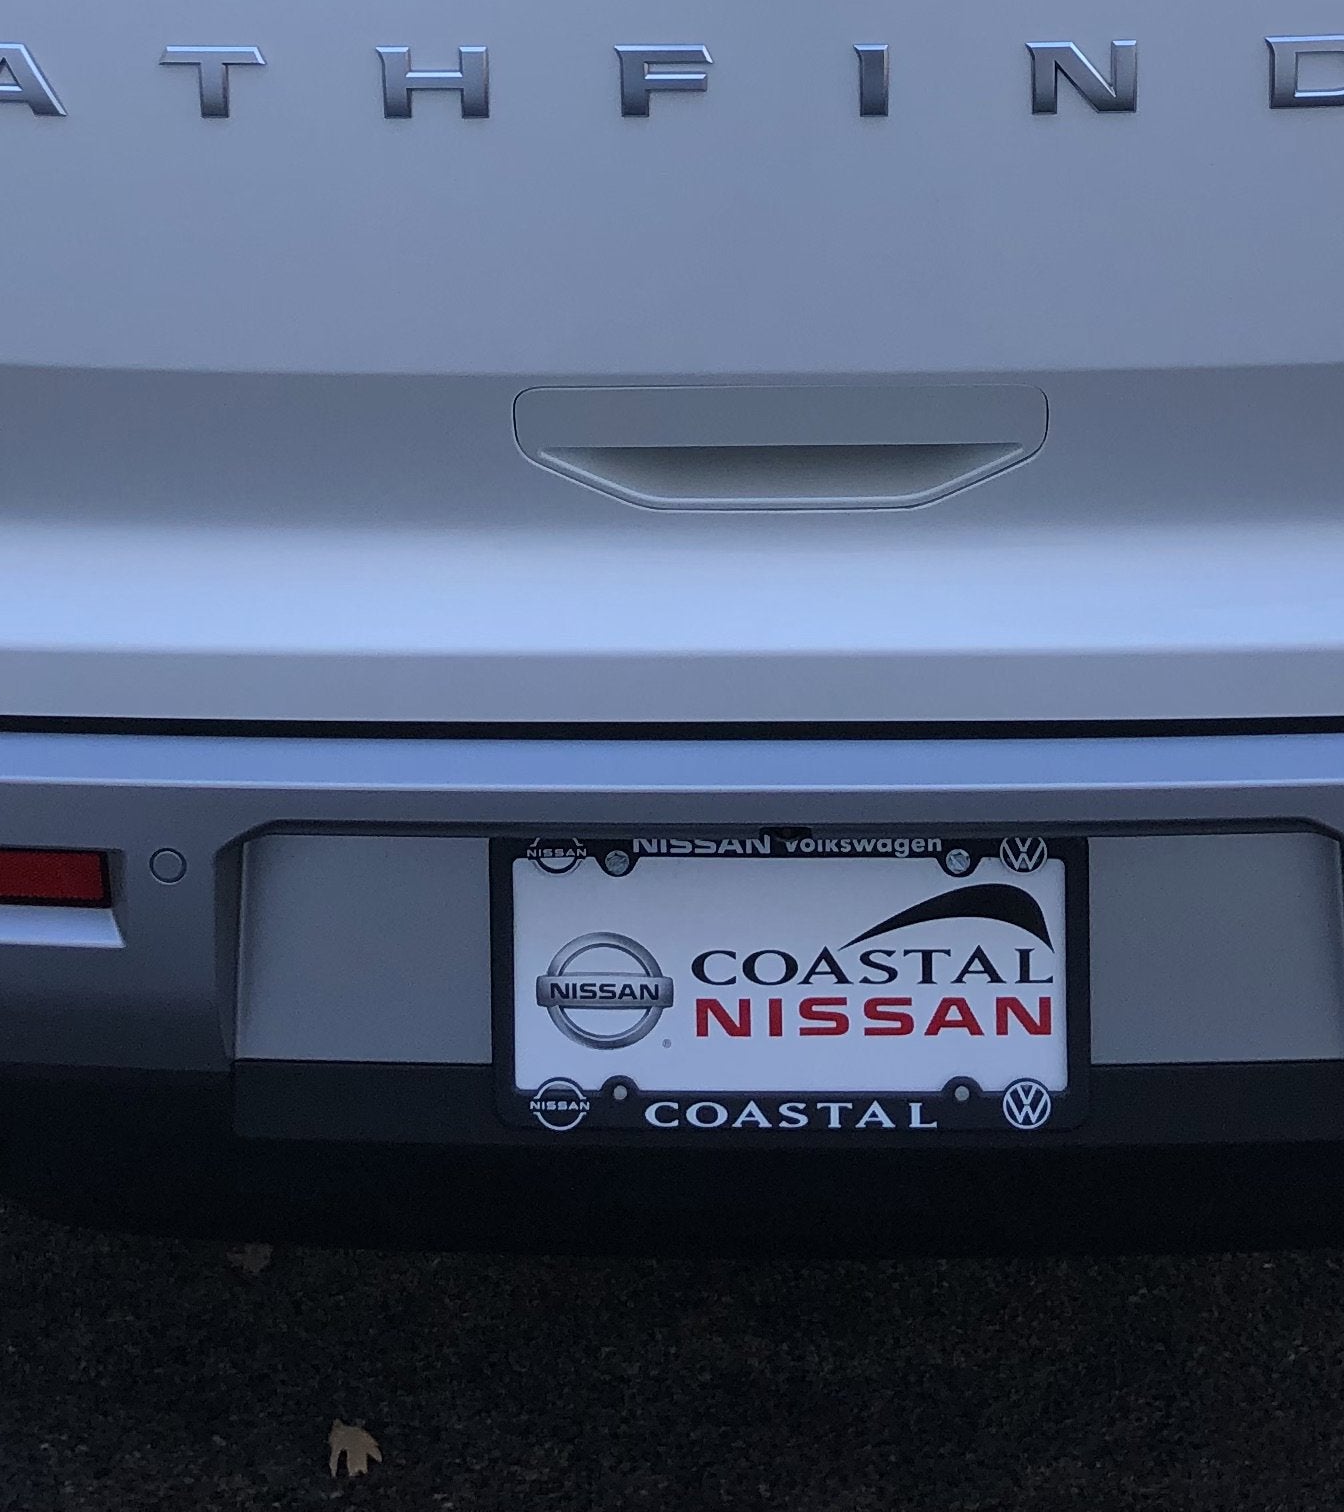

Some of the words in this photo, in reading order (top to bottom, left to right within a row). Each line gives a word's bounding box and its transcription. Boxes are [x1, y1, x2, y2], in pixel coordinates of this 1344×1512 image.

[526, 847, 587, 858] NISSAN
[632, 836, 771, 854] NISSAN
[691, 945, 1055, 986] COASTAL
[550, 982, 659, 1001] NISSAN
[695, 997, 1052, 1038] NISSAN
[529, 1100, 590, 1111] NISSAN
[644, 1100, 938, 1129] COASTAL
